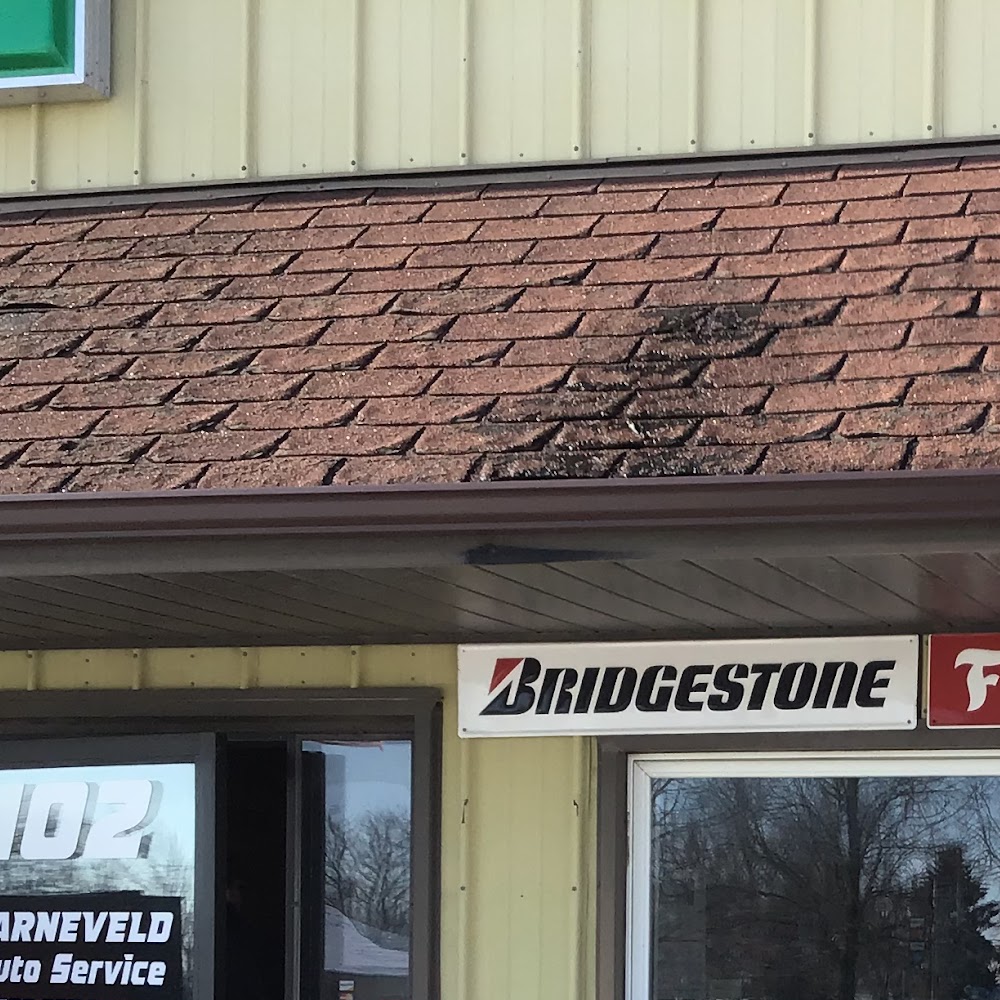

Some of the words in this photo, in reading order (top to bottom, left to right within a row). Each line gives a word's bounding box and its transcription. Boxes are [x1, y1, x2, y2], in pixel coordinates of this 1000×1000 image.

[479, 657, 896, 716] BRIDGESTONE
[0, 911, 174, 943] ARNEVELD
[50, 952, 167, 986] Service
